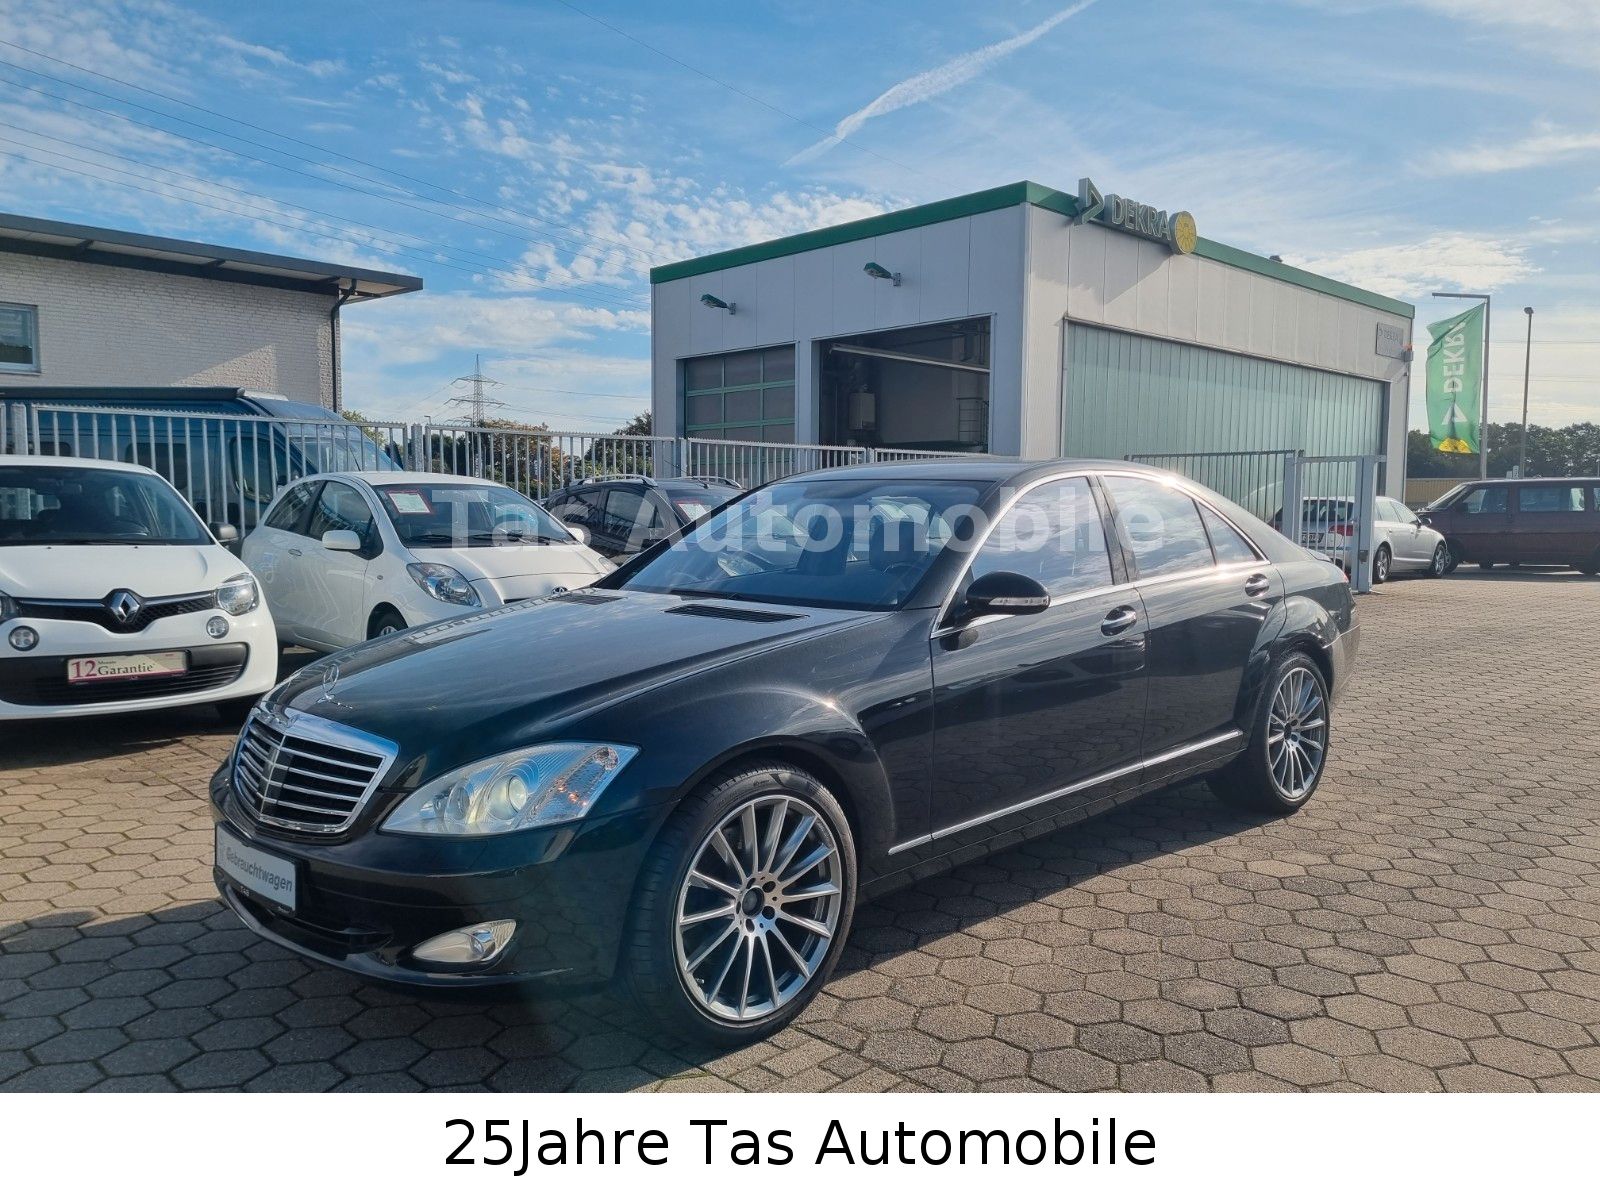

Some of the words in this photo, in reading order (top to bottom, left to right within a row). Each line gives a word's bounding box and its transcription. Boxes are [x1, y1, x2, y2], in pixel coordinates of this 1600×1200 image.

[1105, 194, 1171, 241] DEKRA
[71, 660, 98, 678] 12
[98, 663, 154, 676] Garantie
[226, 846, 293, 892] Gebrauchtwagen
